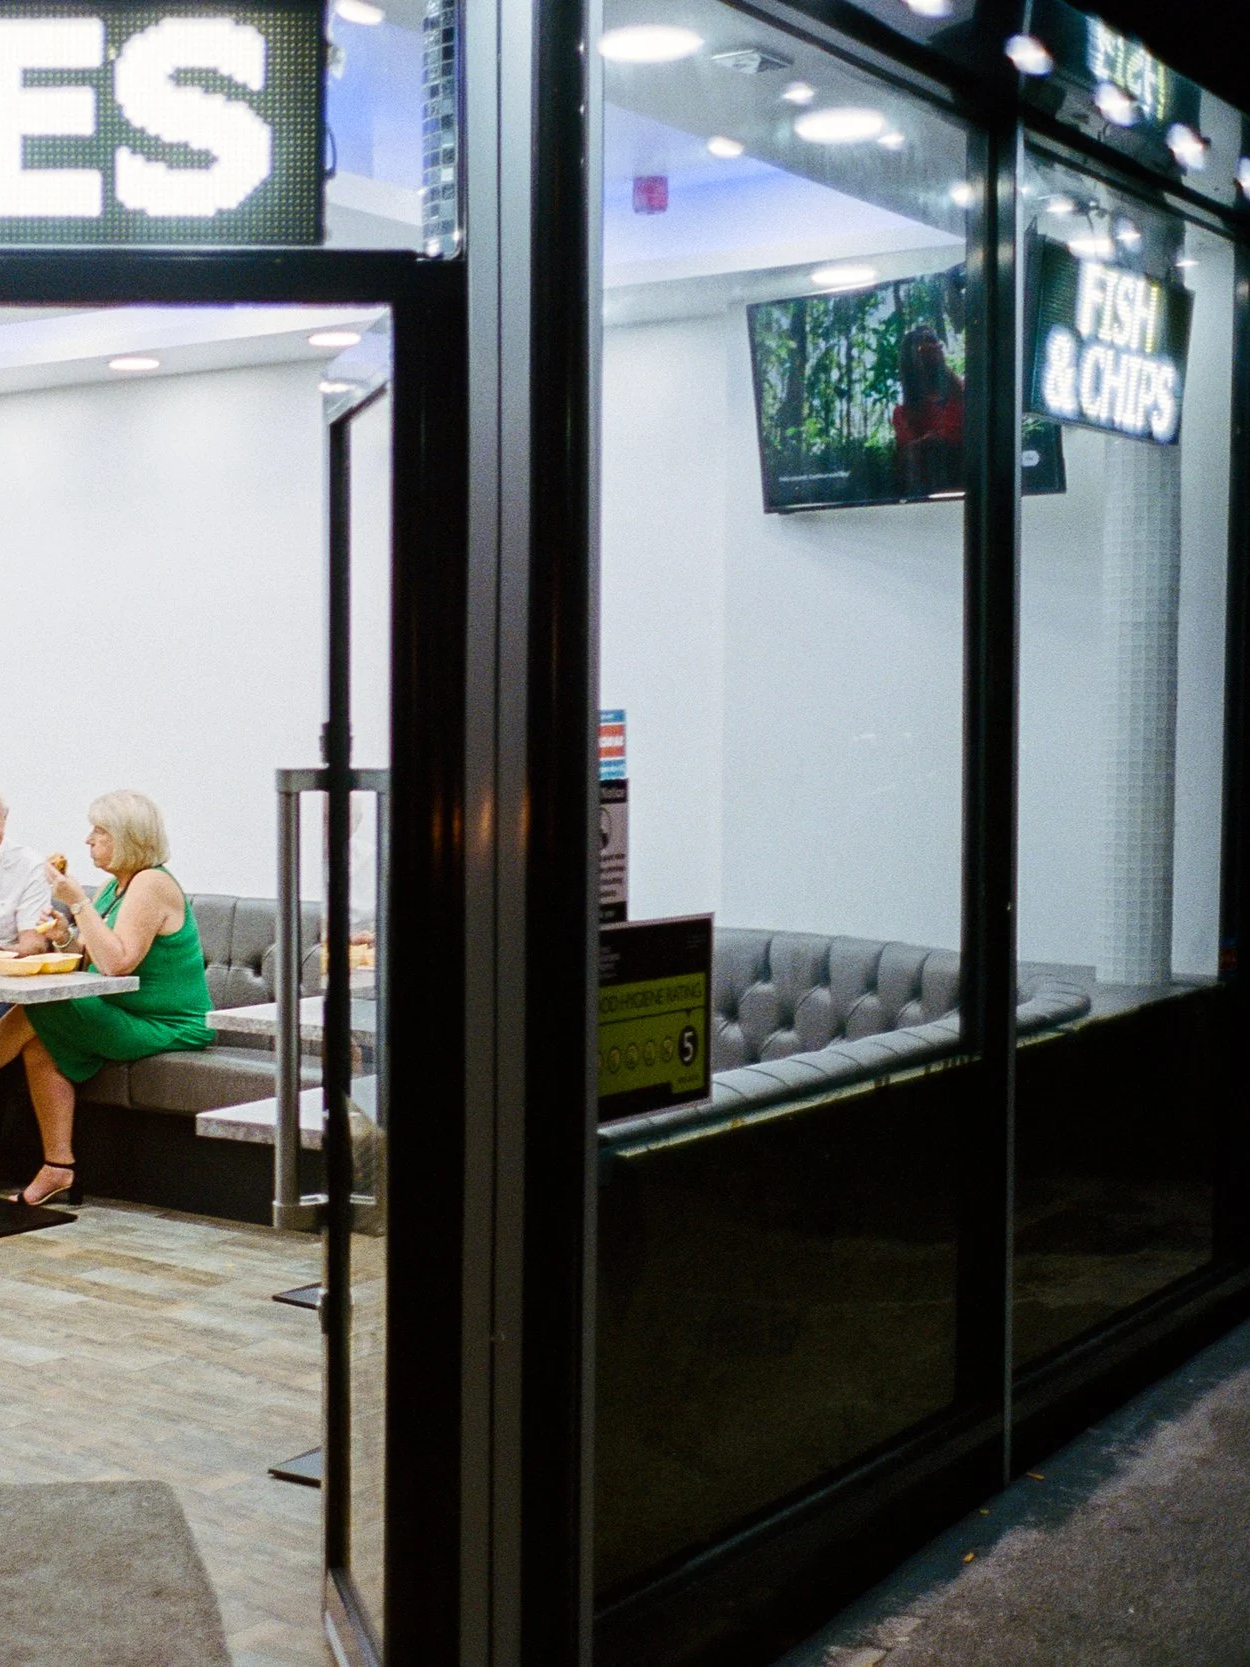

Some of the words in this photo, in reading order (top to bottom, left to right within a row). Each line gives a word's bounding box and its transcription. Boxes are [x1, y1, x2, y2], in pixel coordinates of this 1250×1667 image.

[1078, 261, 1162, 353] FISH
[1045, 330, 1078, 414] &
[1081, 345, 1178, 439] CHIPS
[680, 1031, 694, 1062] 5
